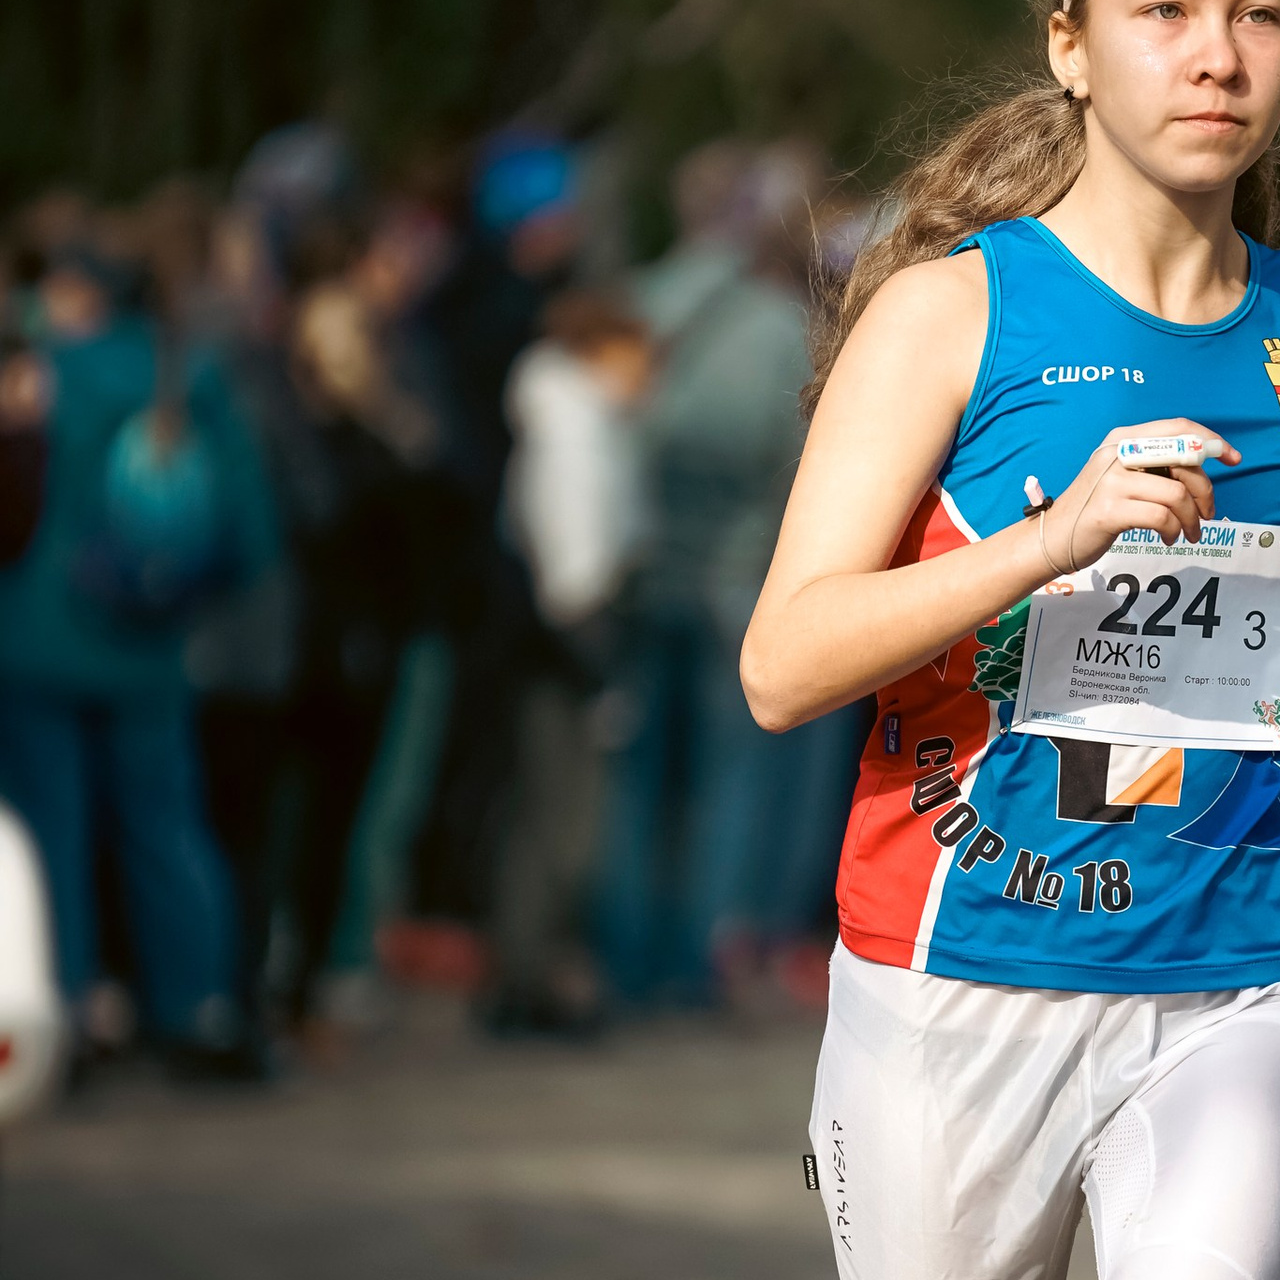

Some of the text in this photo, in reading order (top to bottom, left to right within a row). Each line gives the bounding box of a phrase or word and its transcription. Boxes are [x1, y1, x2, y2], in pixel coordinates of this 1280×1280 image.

[1041, 365, 1145, 386] СШОР 18
[1124, 545, 1139, 555] 2025
[1201, 547, 1232, 559] ЧЕЛОВЕКА
[1097, 574, 1221, 639] 224
[1243, 610, 1267, 650] 3
[1075, 638, 1161, 670] МЖ16
[1072, 665, 1167, 684] Бердникова Вероника
[1217, 677, 1251, 687] 10:00:00
[1070, 677, 1151, 695] Воронежская обл.
[1101, 692, 1140, 706] 8372084
[1030, 709, 1087, 726] ЖЕЛЕЗНОВОДСК
[910, 735, 1007, 873] СШОР
[1072, 859, 1133, 913] 18
